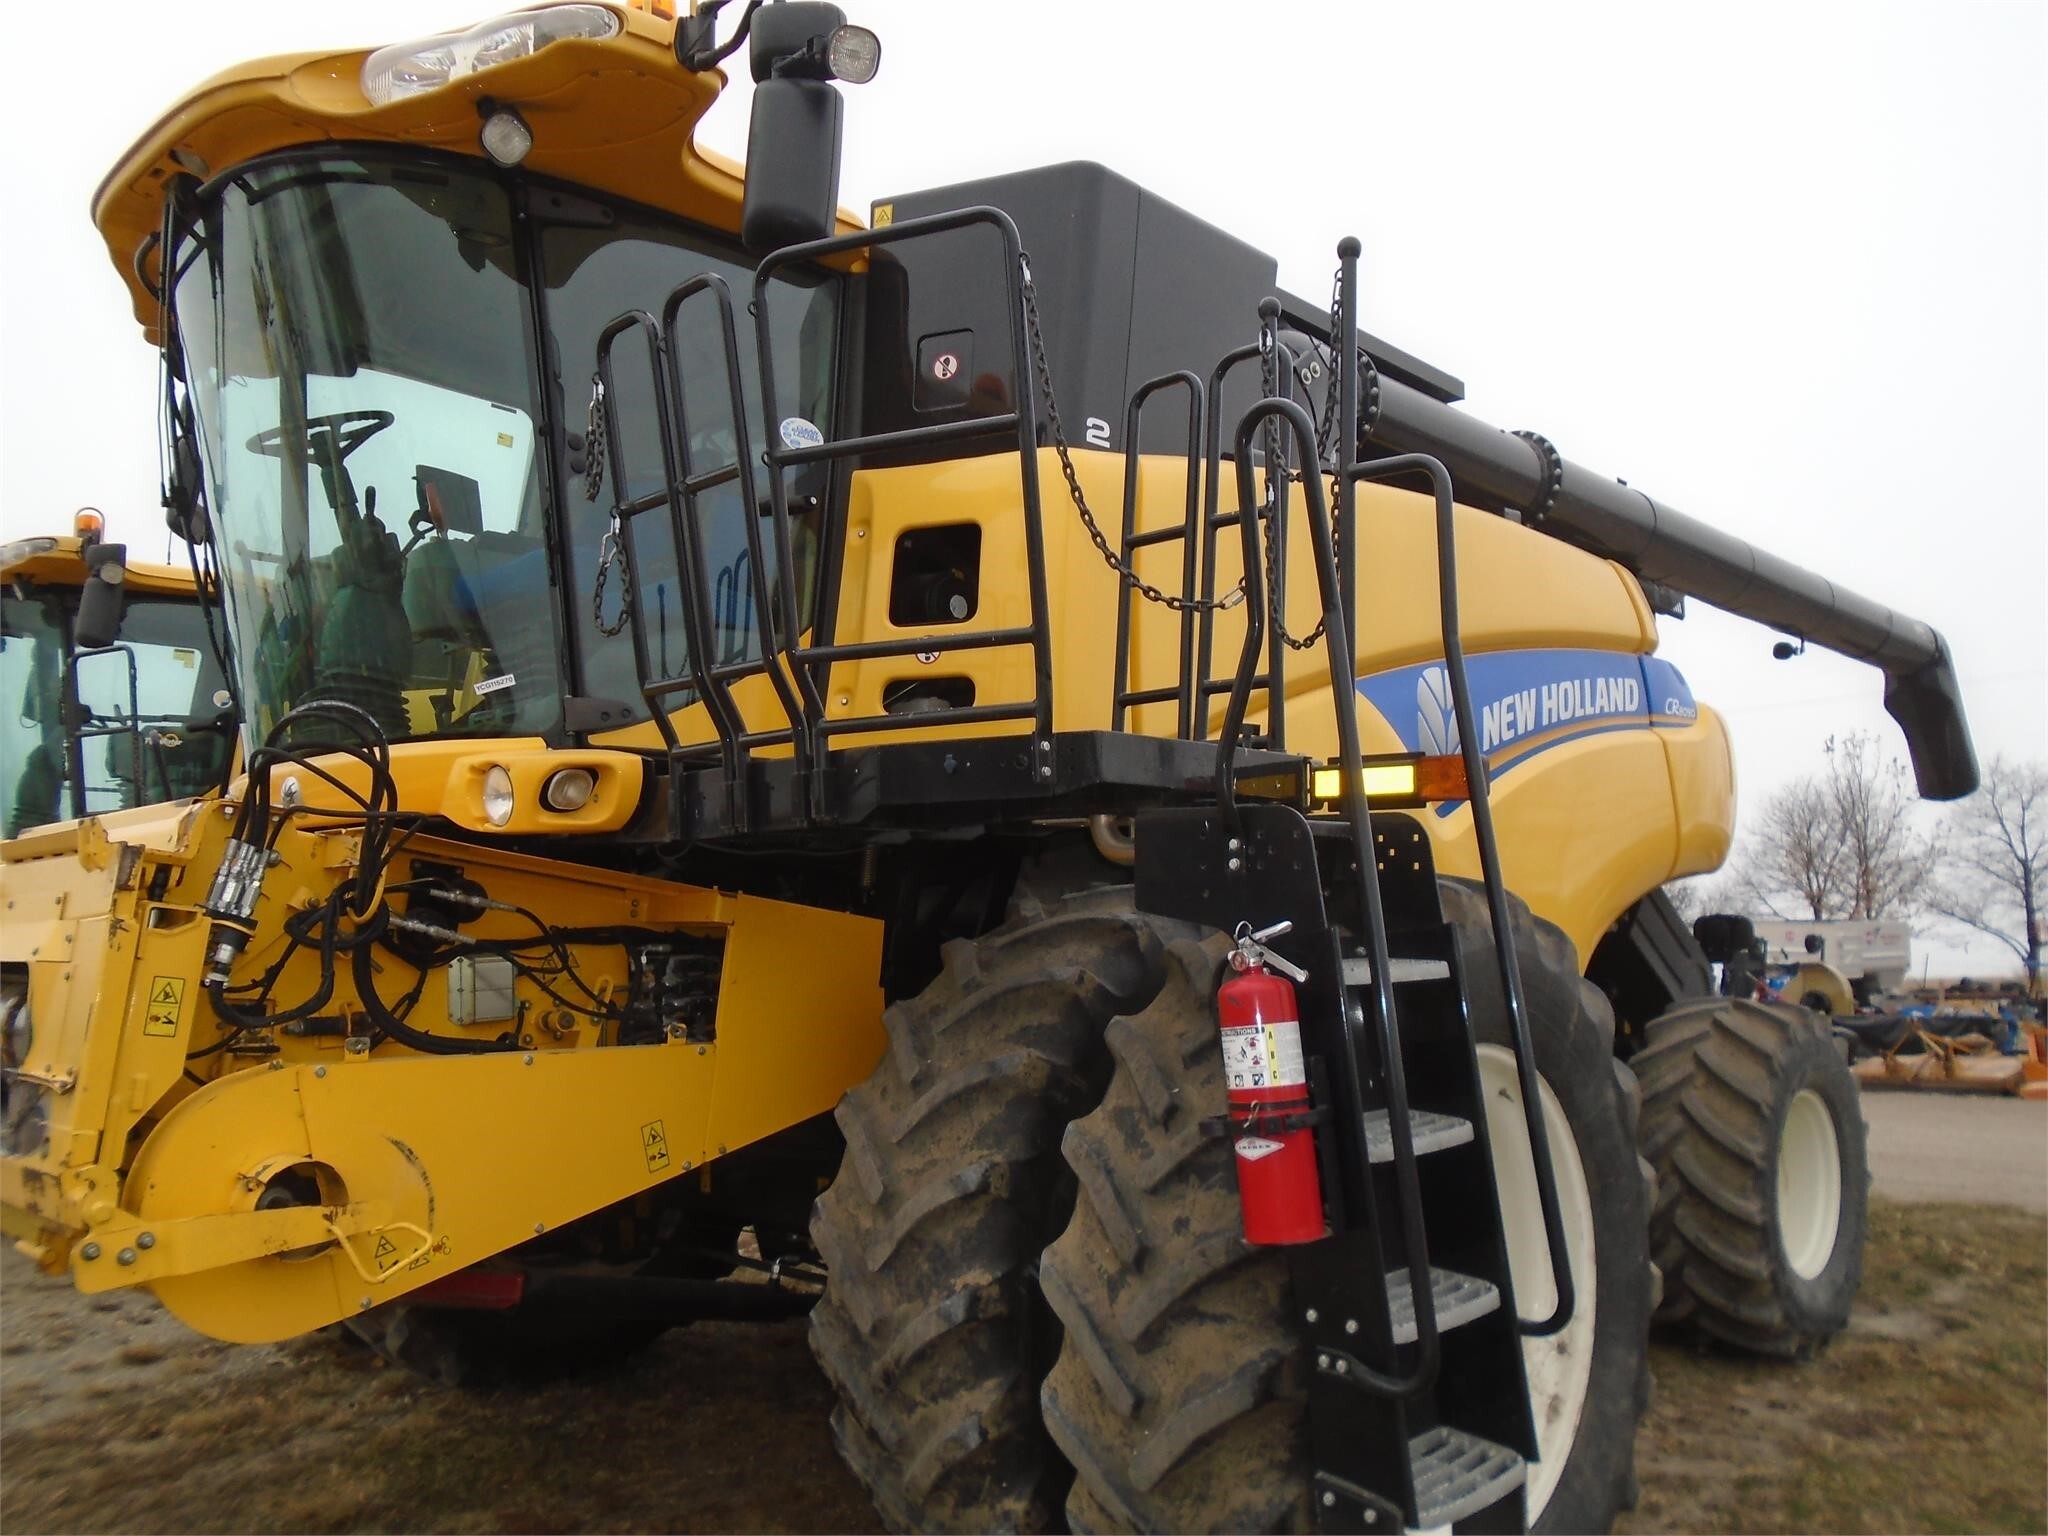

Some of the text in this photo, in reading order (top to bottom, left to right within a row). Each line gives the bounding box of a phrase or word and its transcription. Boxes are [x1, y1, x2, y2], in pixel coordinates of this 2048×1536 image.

[1086, 416, 1111, 449] 2
[1482, 677, 1640, 751] NEW HOLLAND
